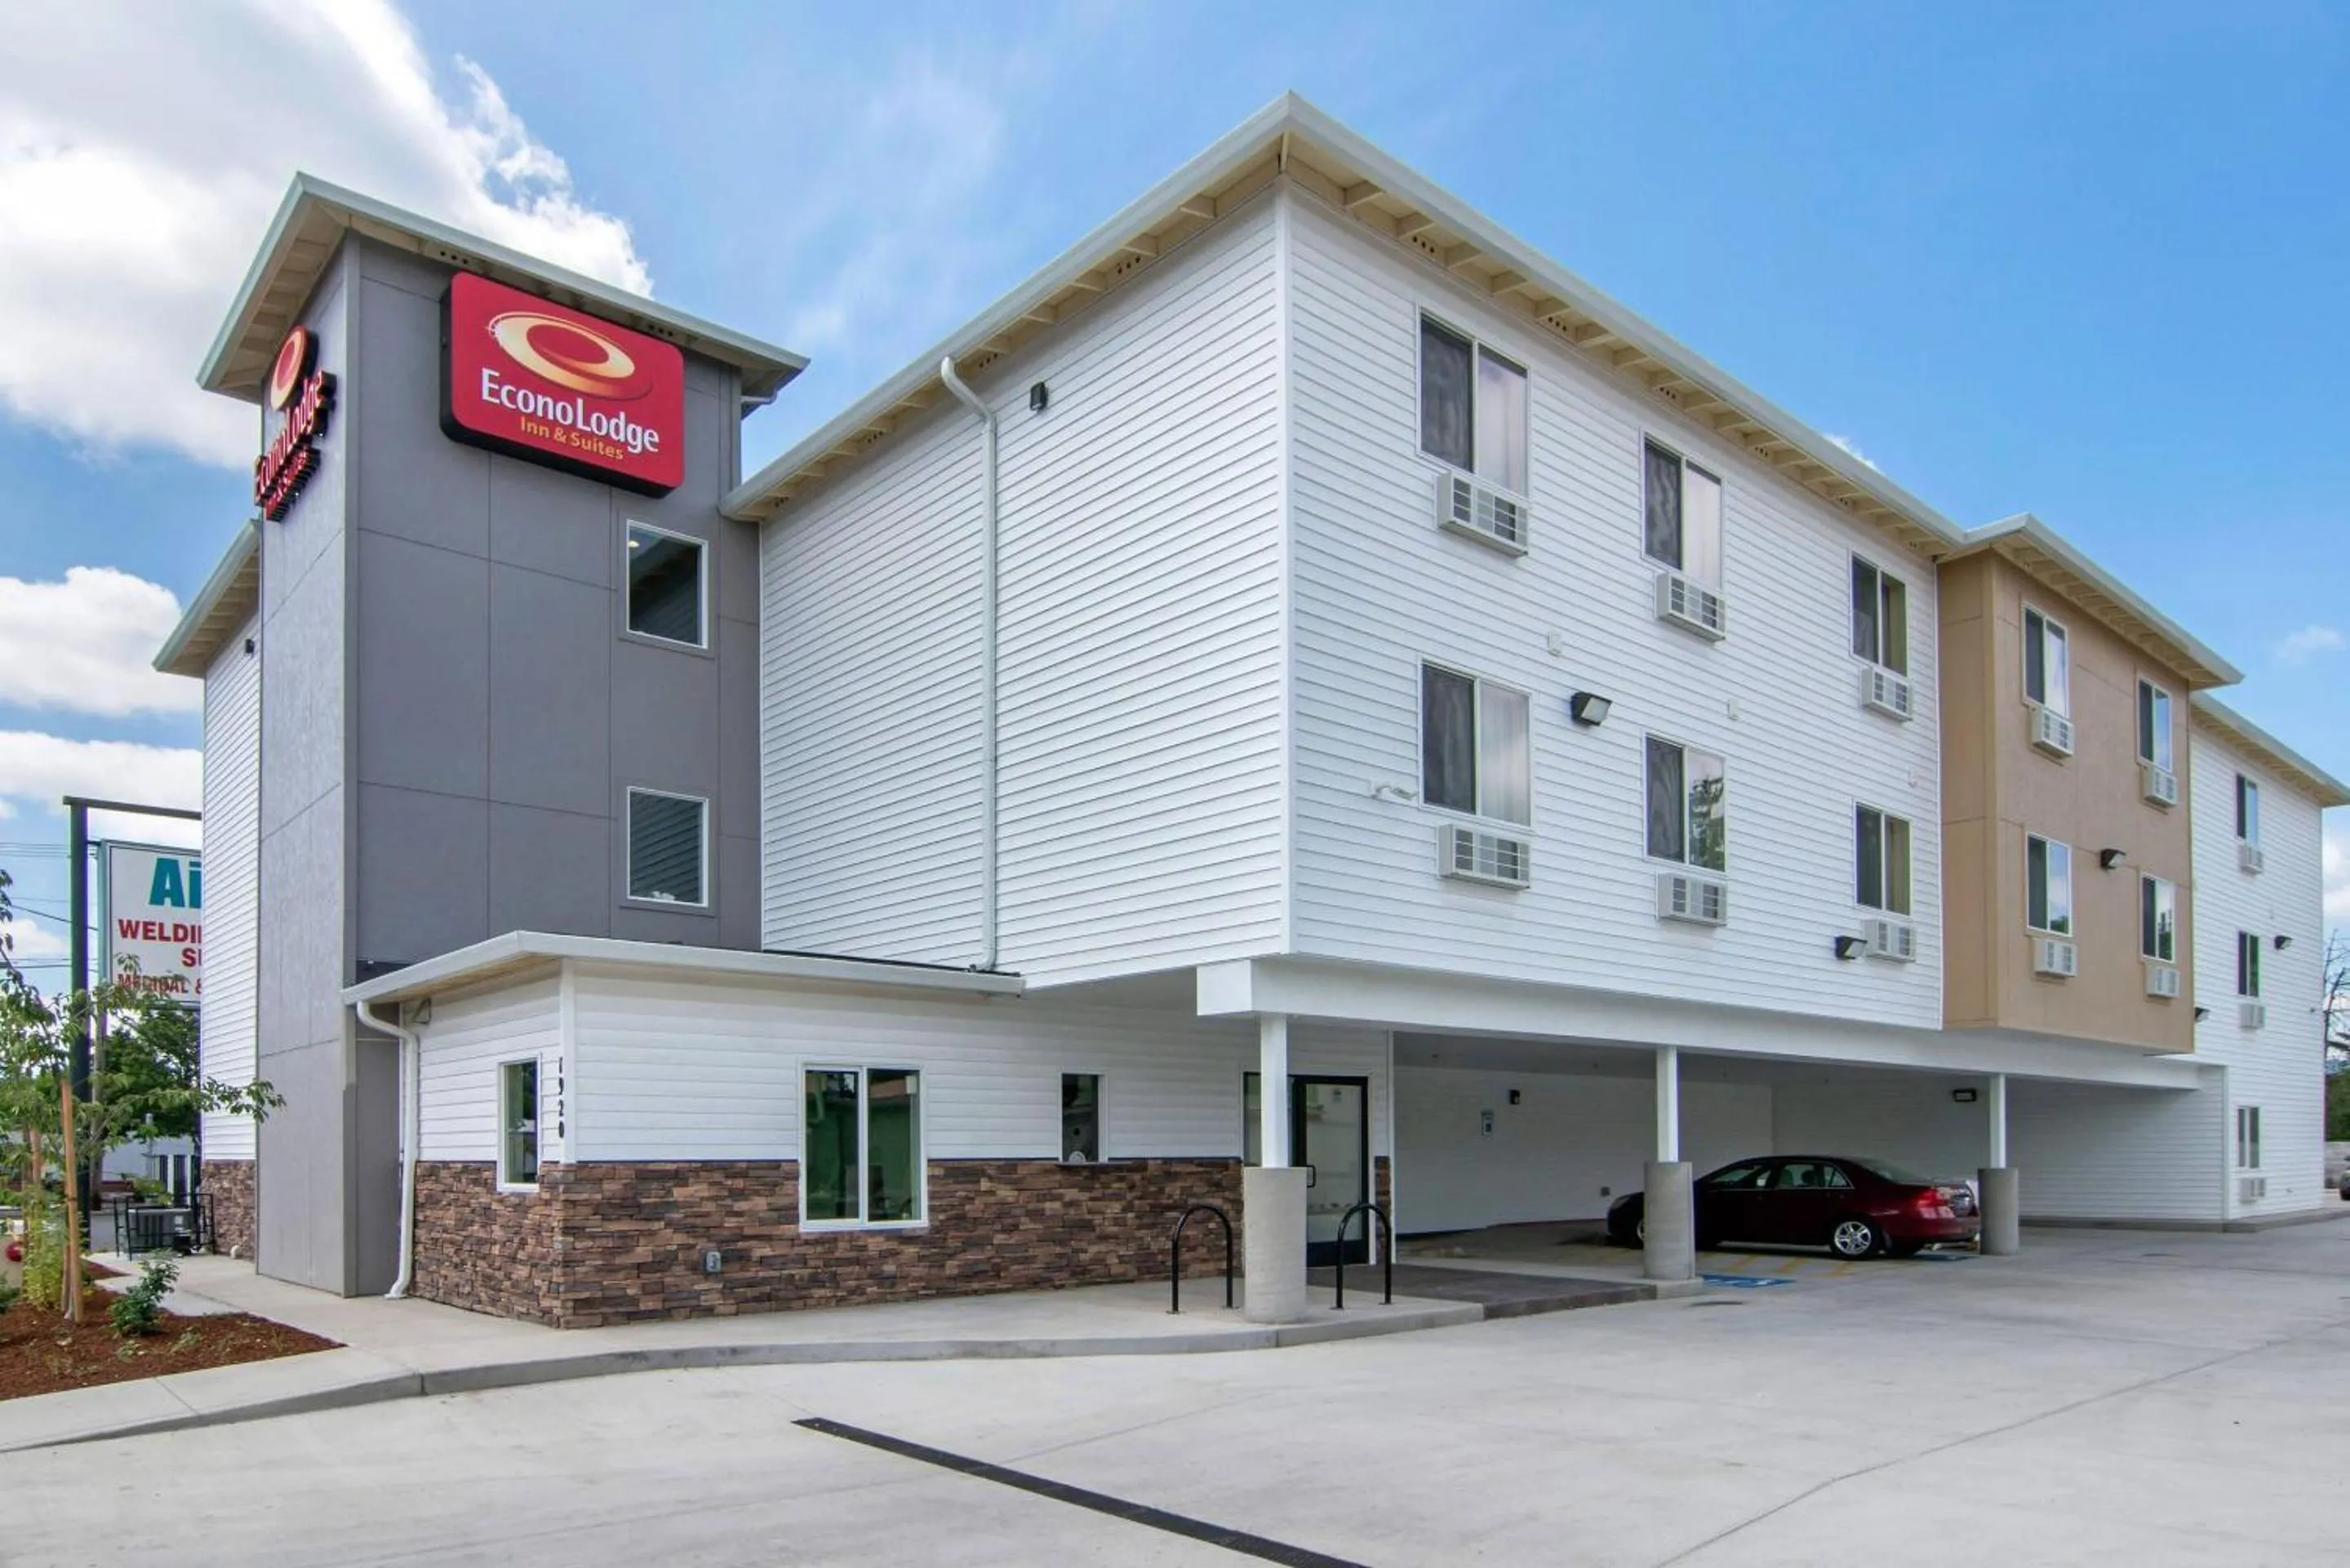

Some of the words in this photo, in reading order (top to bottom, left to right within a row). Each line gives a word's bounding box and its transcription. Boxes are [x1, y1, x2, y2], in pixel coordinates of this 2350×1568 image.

[480, 367, 660, 454] EconoLodge
[520, 415, 550, 438] Inn
[553, 429, 567, 445] &
[571, 433, 624, 460] Suites
